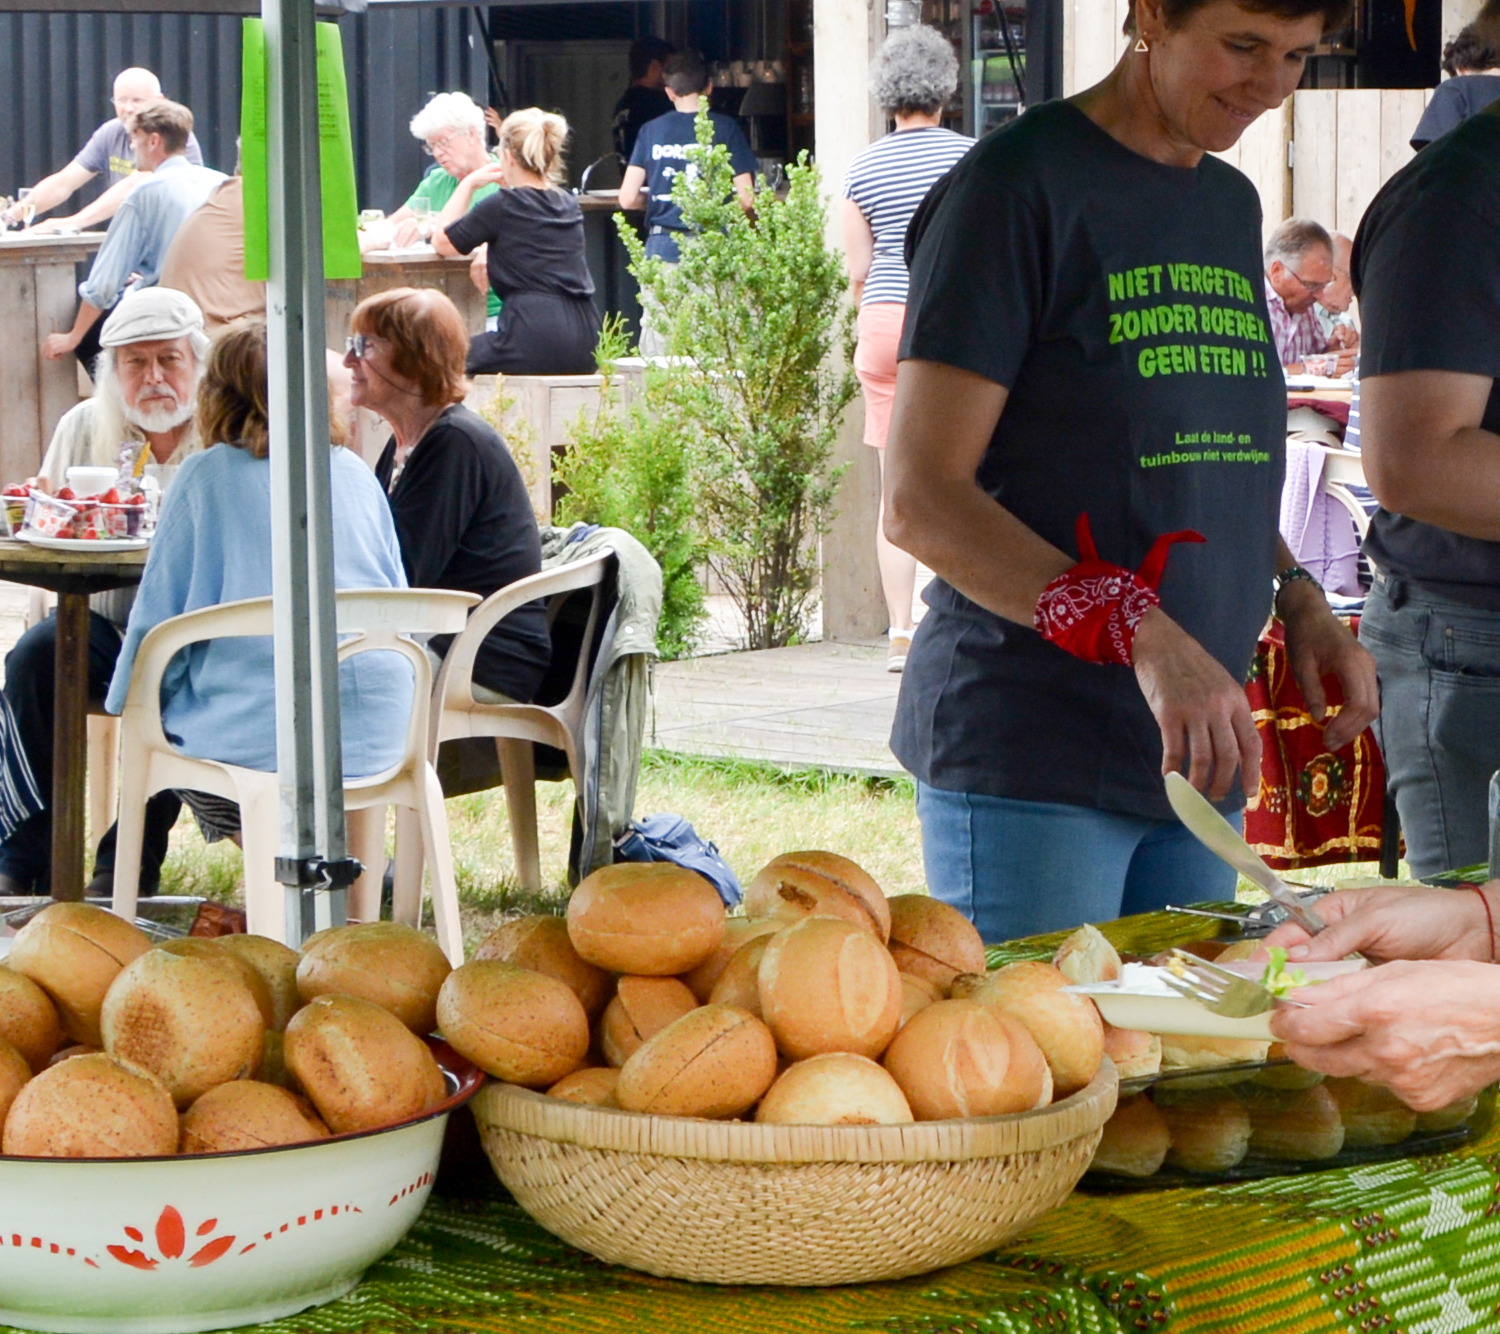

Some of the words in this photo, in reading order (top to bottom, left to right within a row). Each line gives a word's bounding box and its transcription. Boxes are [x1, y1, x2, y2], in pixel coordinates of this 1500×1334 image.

[1108, 265, 1163, 302] NIET
[1167, 262, 1255, 304] VERGETEN
[1108, 304, 1199, 345] ZONDER
[1199, 305, 1270, 344] BOEREN
[1138, 345, 1197, 378] GEEN
[1199, 344, 1247, 377] ETEN
[1251, 350, 1268, 378] !!
[1237, 432, 1251, 444] en
[1139, 450, 1201, 468] tuinbouw
